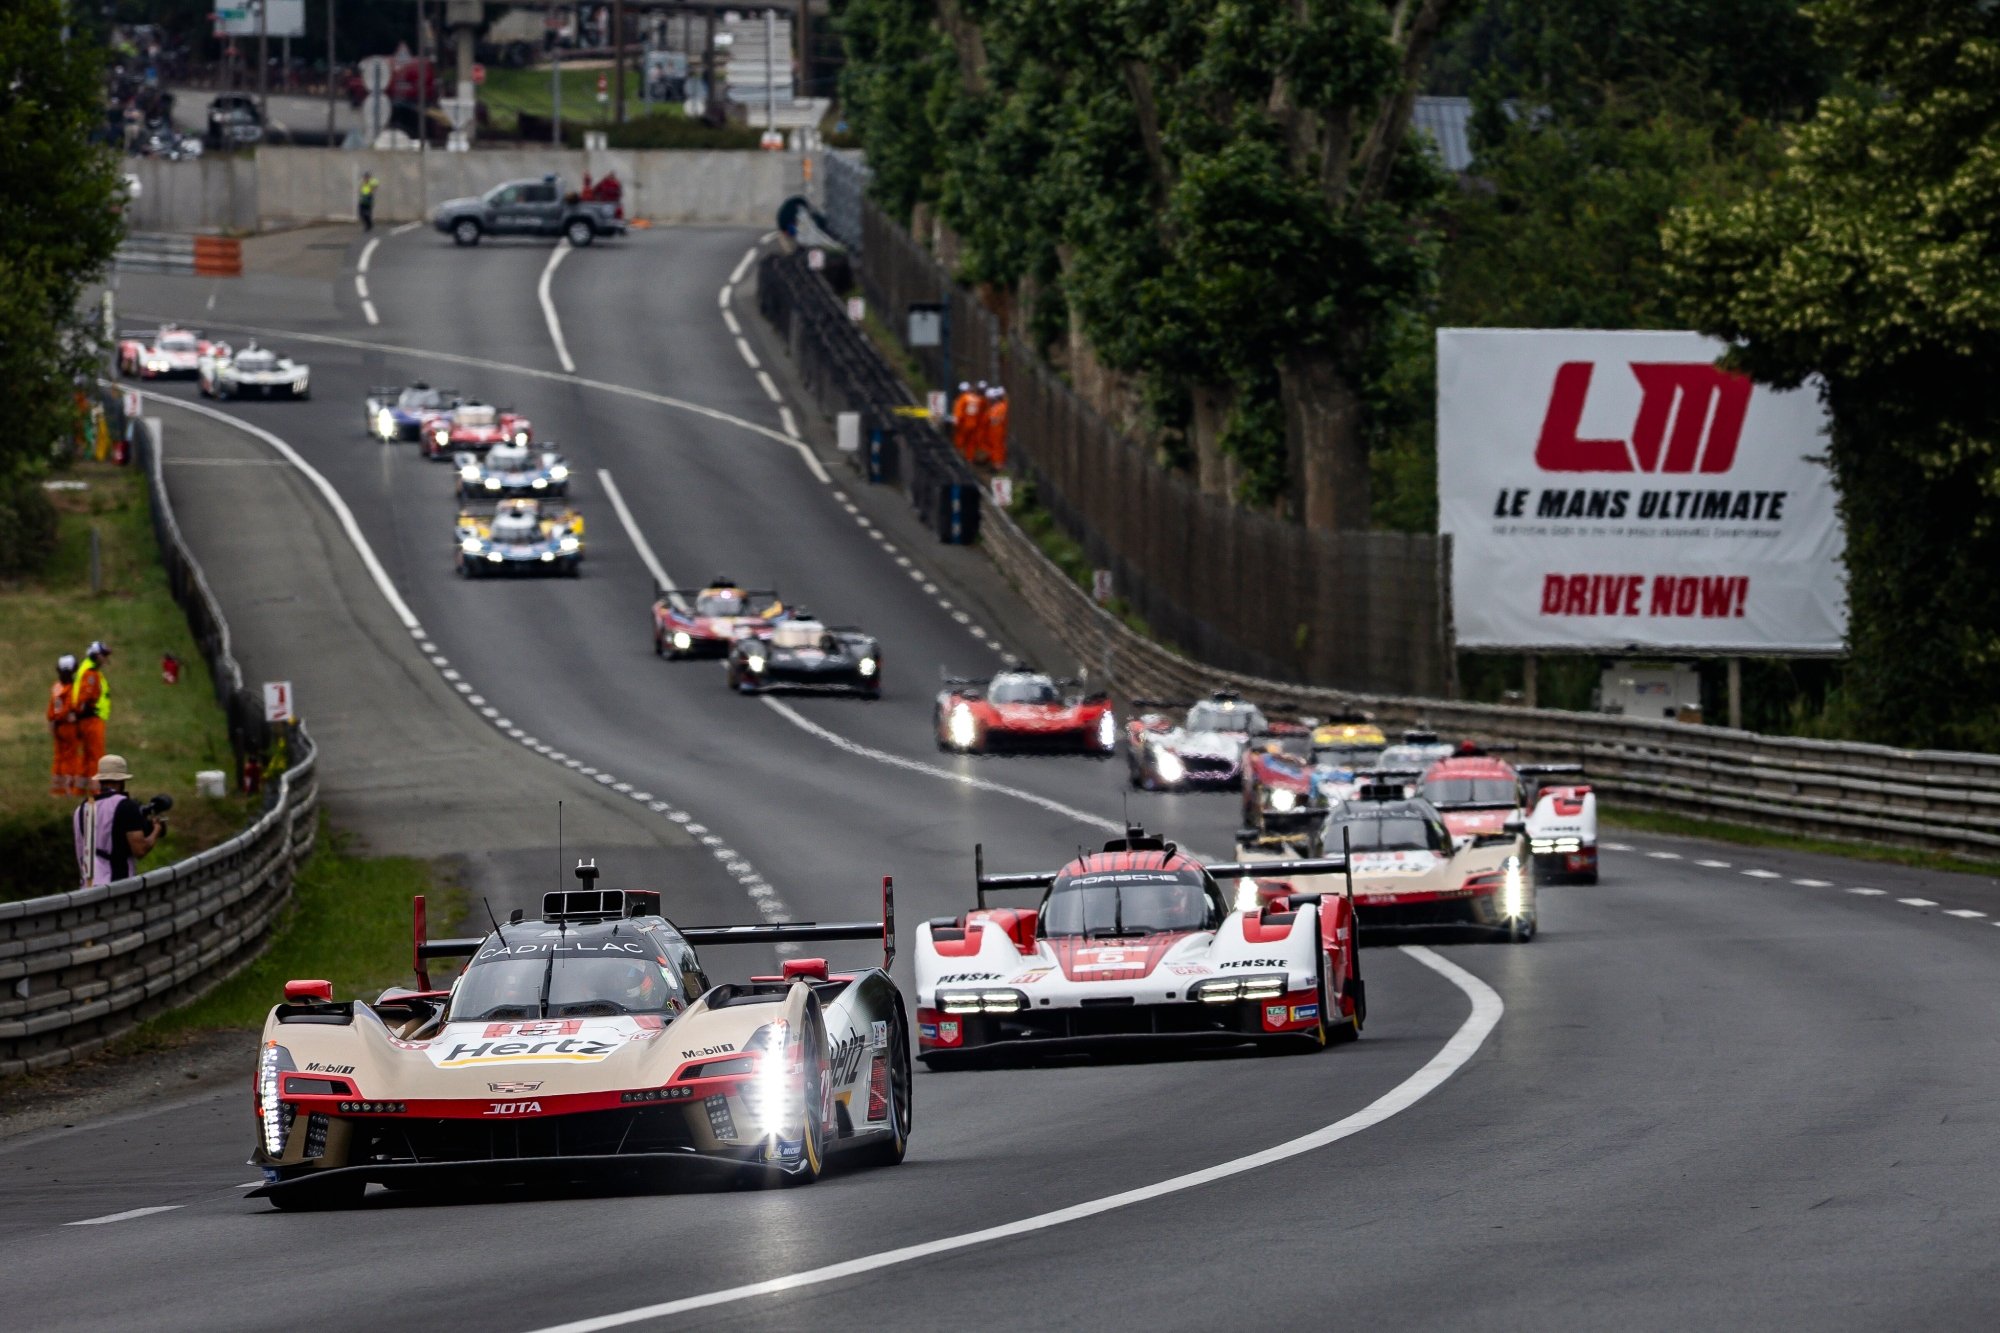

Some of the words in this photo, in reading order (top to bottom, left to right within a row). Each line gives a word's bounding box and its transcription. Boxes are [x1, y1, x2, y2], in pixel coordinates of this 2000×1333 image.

[1494, 488, 1530, 518] LE
[1536, 489, 1629, 519] MANS
[1637, 490, 1787, 520] ULTIMATE
[1540, 574, 1645, 616] DRIVE
[1650, 576, 1749, 618] NOW!
[1070, 874, 1179, 887] PORSCHE
[479, 942, 643, 960] CADILLAC
[1219, 958, 1289, 970] PENSKE
[936, 972, 1005, 985] PENSKE
[443, 1038, 618, 1061] Hertz
[483, 1101, 542, 1115] JOTA
